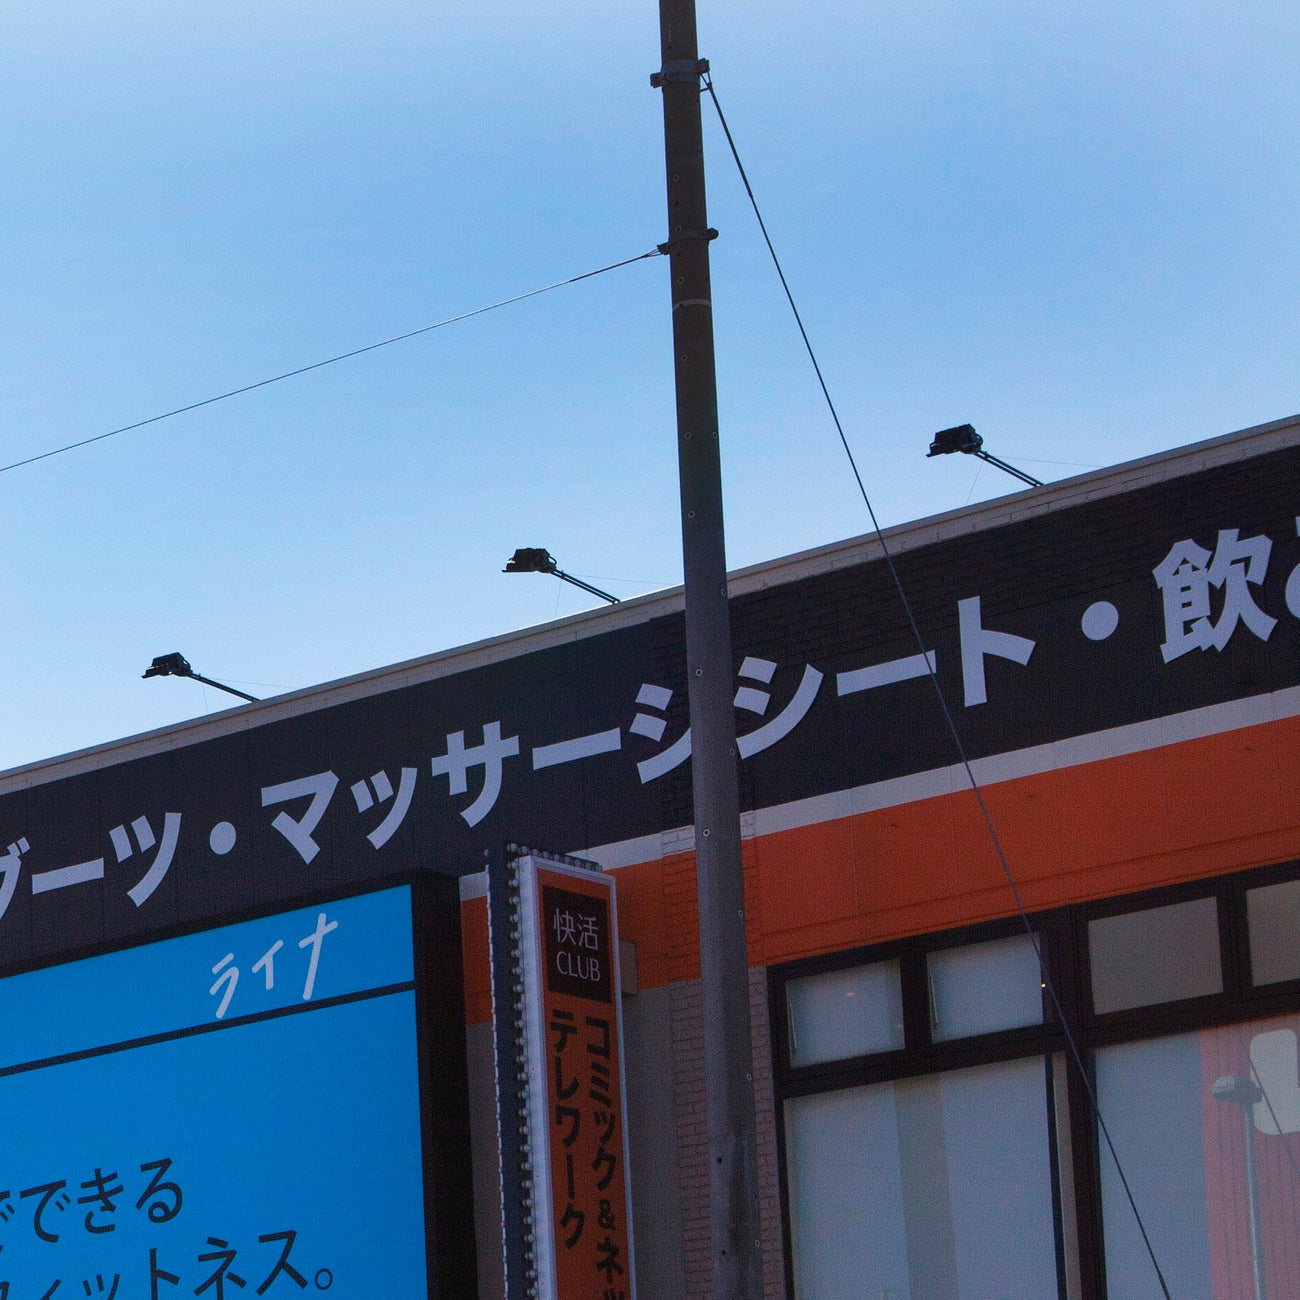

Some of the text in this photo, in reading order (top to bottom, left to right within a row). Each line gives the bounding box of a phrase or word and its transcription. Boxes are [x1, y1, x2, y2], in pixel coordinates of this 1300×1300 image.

[553, 908, 599, 950] 快活
[556, 951, 601, 982] CLUB
[550, 1008, 586, 1248] テレワーク
